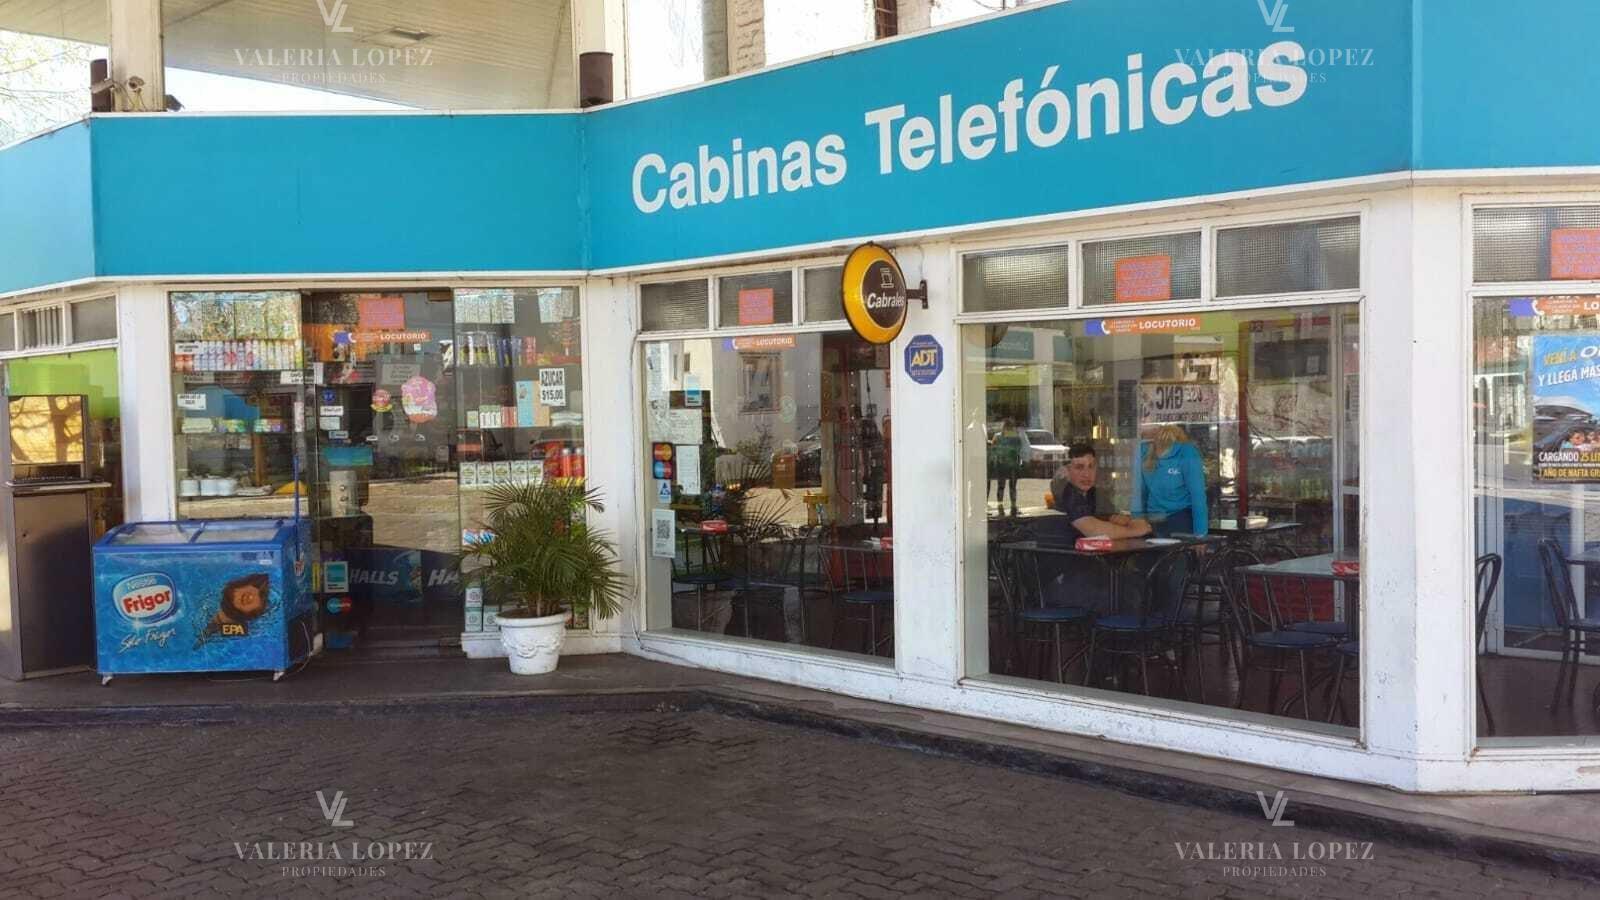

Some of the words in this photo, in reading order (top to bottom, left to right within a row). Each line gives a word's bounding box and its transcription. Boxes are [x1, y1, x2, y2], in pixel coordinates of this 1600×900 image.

[632, 134, 848, 214] Cabinas
[865, 39, 1309, 175] Telefónicas
[867, 292, 904, 308] Cabrales
[1139, 318, 1197, 329] LOCUTORIO
[380, 332, 427, 341] LOCUTORIO
[911, 350, 937, 366] ADT
[1581, 345, 1600, 358] O
[540, 370, 564, 386] AZUCAR
[1538, 375, 1545, 387] Y
[1538, 451, 1579, 462] CARGANDO
[349, 569, 399, 585] HALLS
[123, 591, 171, 613] Frigor
[223, 625, 245, 635] EPA
